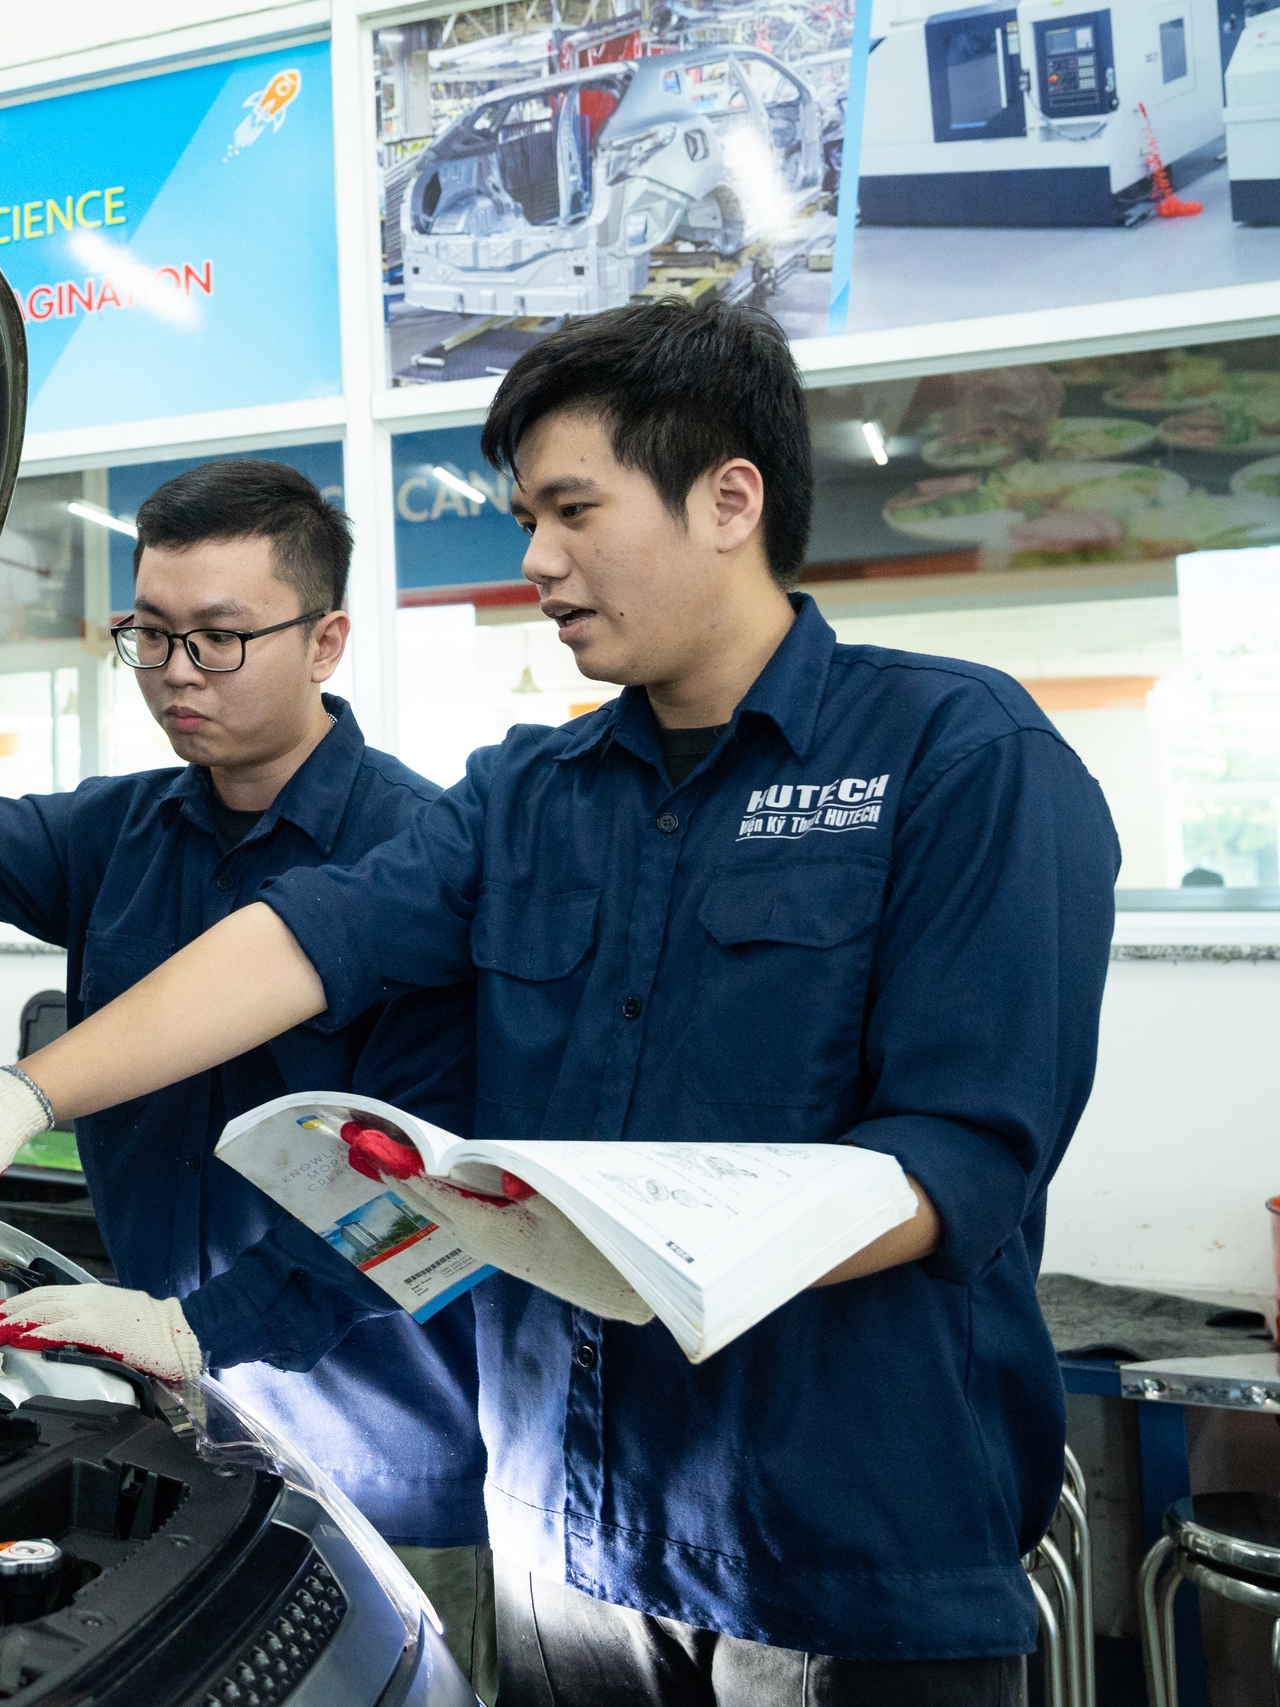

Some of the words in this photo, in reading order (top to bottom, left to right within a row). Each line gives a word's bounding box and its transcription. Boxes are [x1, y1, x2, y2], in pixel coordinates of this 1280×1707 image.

[14, 262, 211, 320] GINAON
[746, 774, 890, 813] HUTECH
[767, 815, 786, 835] Kỹ
[824, 805, 882, 827] HUTECH
